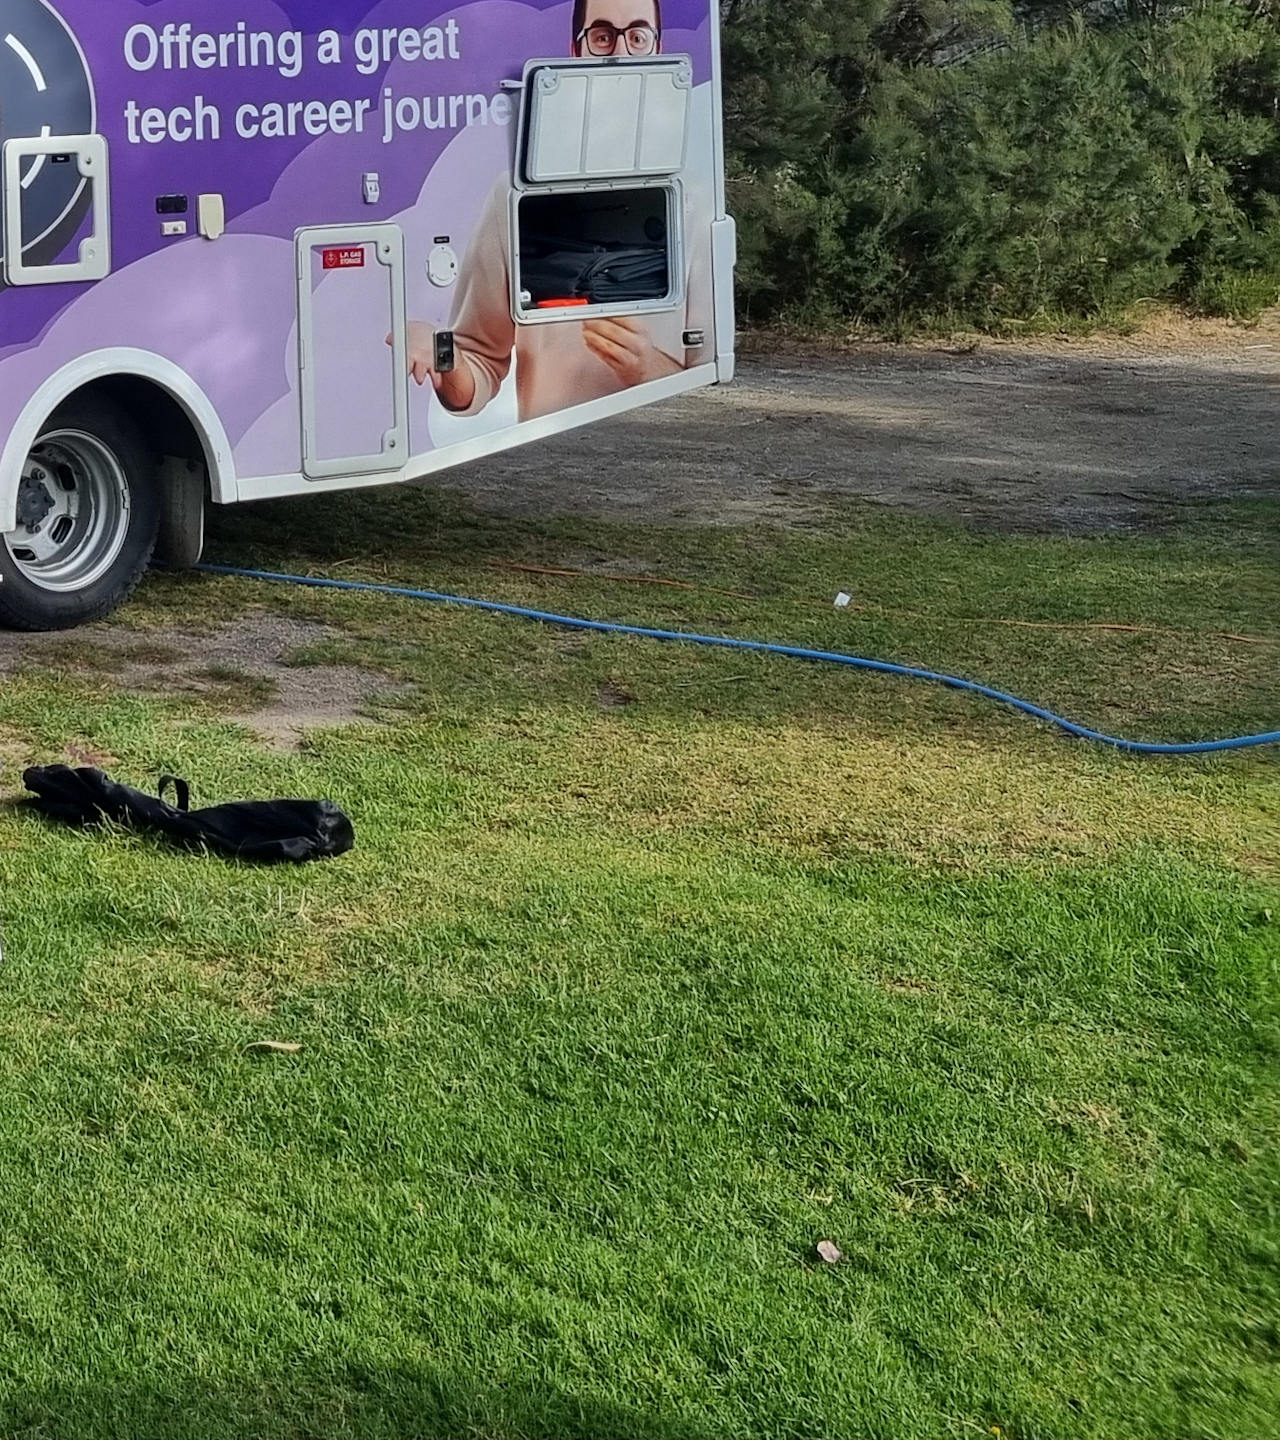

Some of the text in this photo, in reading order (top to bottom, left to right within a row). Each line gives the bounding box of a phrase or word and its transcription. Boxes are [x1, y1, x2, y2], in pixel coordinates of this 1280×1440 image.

[123, 18, 460, 78] Offering a great
[123, 87, 513, 144] tech career journe
